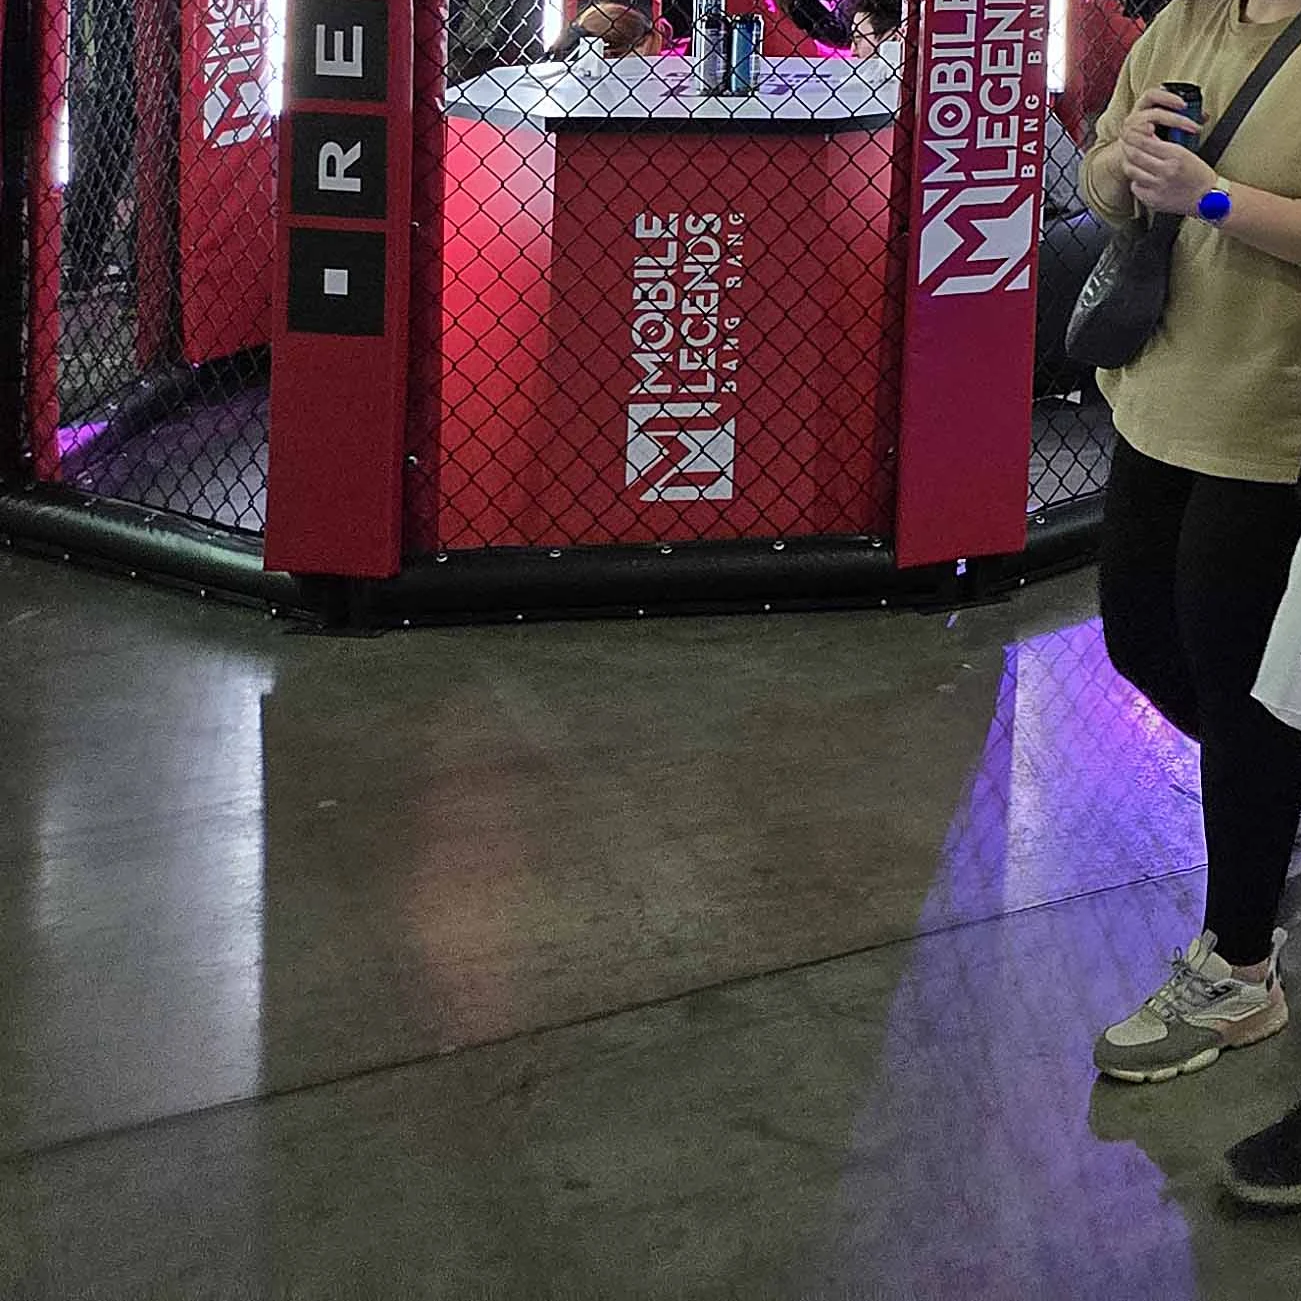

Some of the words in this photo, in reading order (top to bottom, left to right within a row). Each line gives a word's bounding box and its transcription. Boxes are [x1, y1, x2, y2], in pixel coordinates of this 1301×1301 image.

[1021, 94, 1039, 179] BANG
[725, 212, 745, 289] BANG
[629, 212, 680, 395] MOBILE
[680, 212, 722, 395] LEGENDS
[721, 316, 741, 393] BANG
